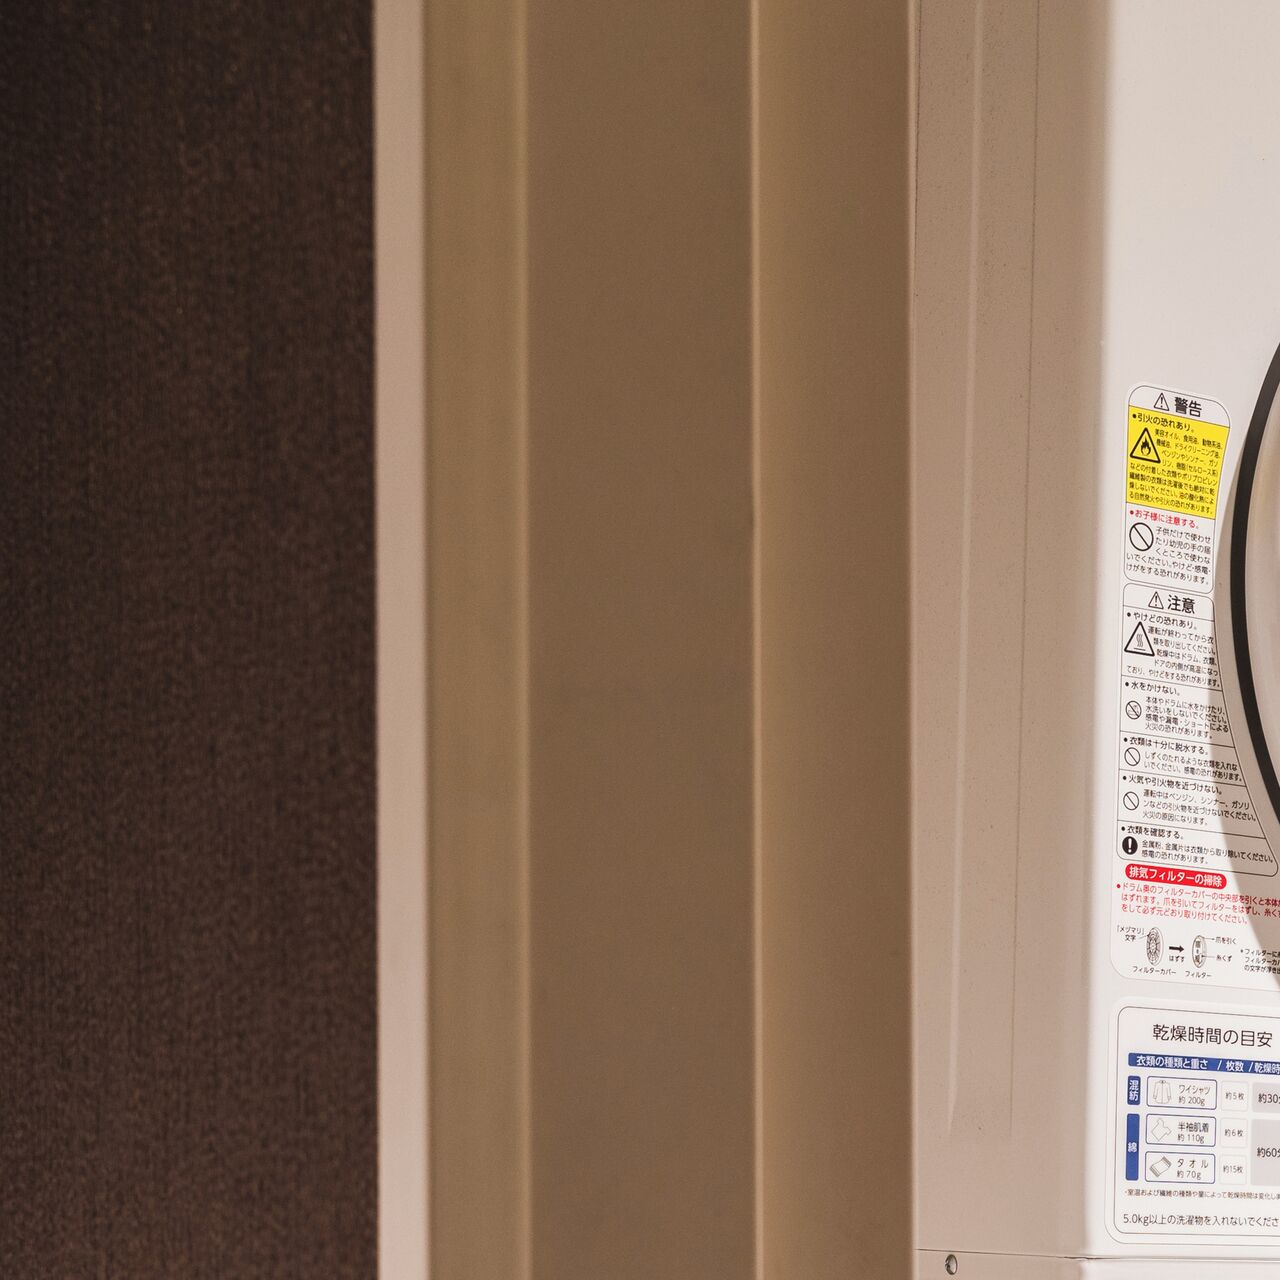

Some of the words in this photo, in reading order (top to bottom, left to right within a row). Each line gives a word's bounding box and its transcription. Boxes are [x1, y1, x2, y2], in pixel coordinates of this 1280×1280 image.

[1174, 396, 1202, 417] 警告
[1137, 413, 1194, 433] 引火の恐れあり。
[1135, 510, 1199, 530] お子様に注意する。
[1155, 527, 1210, 543] 子供だけで使わせ
[1155, 537, 1210, 554] たり幼児の手の届
[1156, 548, 1210, 564] くところで使わな
[1126, 564, 1209, 585] けがをする恐れがあります。
[1167, 594, 1195, 614] 注意
[1133, 612, 1197, 630] やけどの恐れあり。
[1148, 626, 1214, 644] 運転が終わってから衣
[1153, 638, 1215, 654] 類を取り出してください。
[1157, 649, 1217, 665] 乾燥中はドラム、衣類、
[1127, 665, 1220, 687] ており、やけどをする恐れがあります。
[1154, 660, 1218, 676] ドアの内側が高温になっ
[1131, 681, 1180, 696] 水をかけない。
[1145, 696, 1225, 715] 本体やドラムに水をかけたり、
[1145, 706, 1227, 723] 水洗いをしないでください。
[1145, 714, 1228, 733] 感電や漏電・ショートによる
[1145, 723, 1213, 739] 火災の恐れがあります。
[1130, 736, 1208, 755] 衣類は十分に脱水する。
[1144, 752, 1237, 770] しずくのたれるような衣類を入れな
[1144, 762, 1242, 782] いでください。感電の恐れがあります。
[1129, 774, 1222, 795] 火気や引火物を近づけない。
[1142, 811, 1208, 826] 火災の原因になります。
[1143, 800, 1256, 822] ンなどの引火物を近づけないでください。
[1127, 826, 1183, 840] 衣類を確認する。
[1141, 851, 1209, 865] 感電の恐れがあります。
[1129, 866, 1223, 887] 排気フィルターの掃除
[1121, 903, 1248, 925] をして必ず元どおり取り付けてください。
[1132, 966, 1176, 975] フィルターカバー
[1153, 1024, 1273, 1047] 乾燥時間の目安
[1137, 1055, 1207, 1069] 衣類の種類と重さ
[1226, 1060, 1244, 1072] 枚数
[1129, 1080, 1138, 1102] 混紡
[1179, 1085, 1210, 1094] ワイシャツ
[1188, 1096, 1205, 1106] 200g
[1178, 1122, 1209, 1132] 半袖肌着
[1188, 1134, 1204, 1144] 110g
[1187, 1171, 1201, 1180] 70g
[1223, 1165, 1243, 1174] 約15枚
